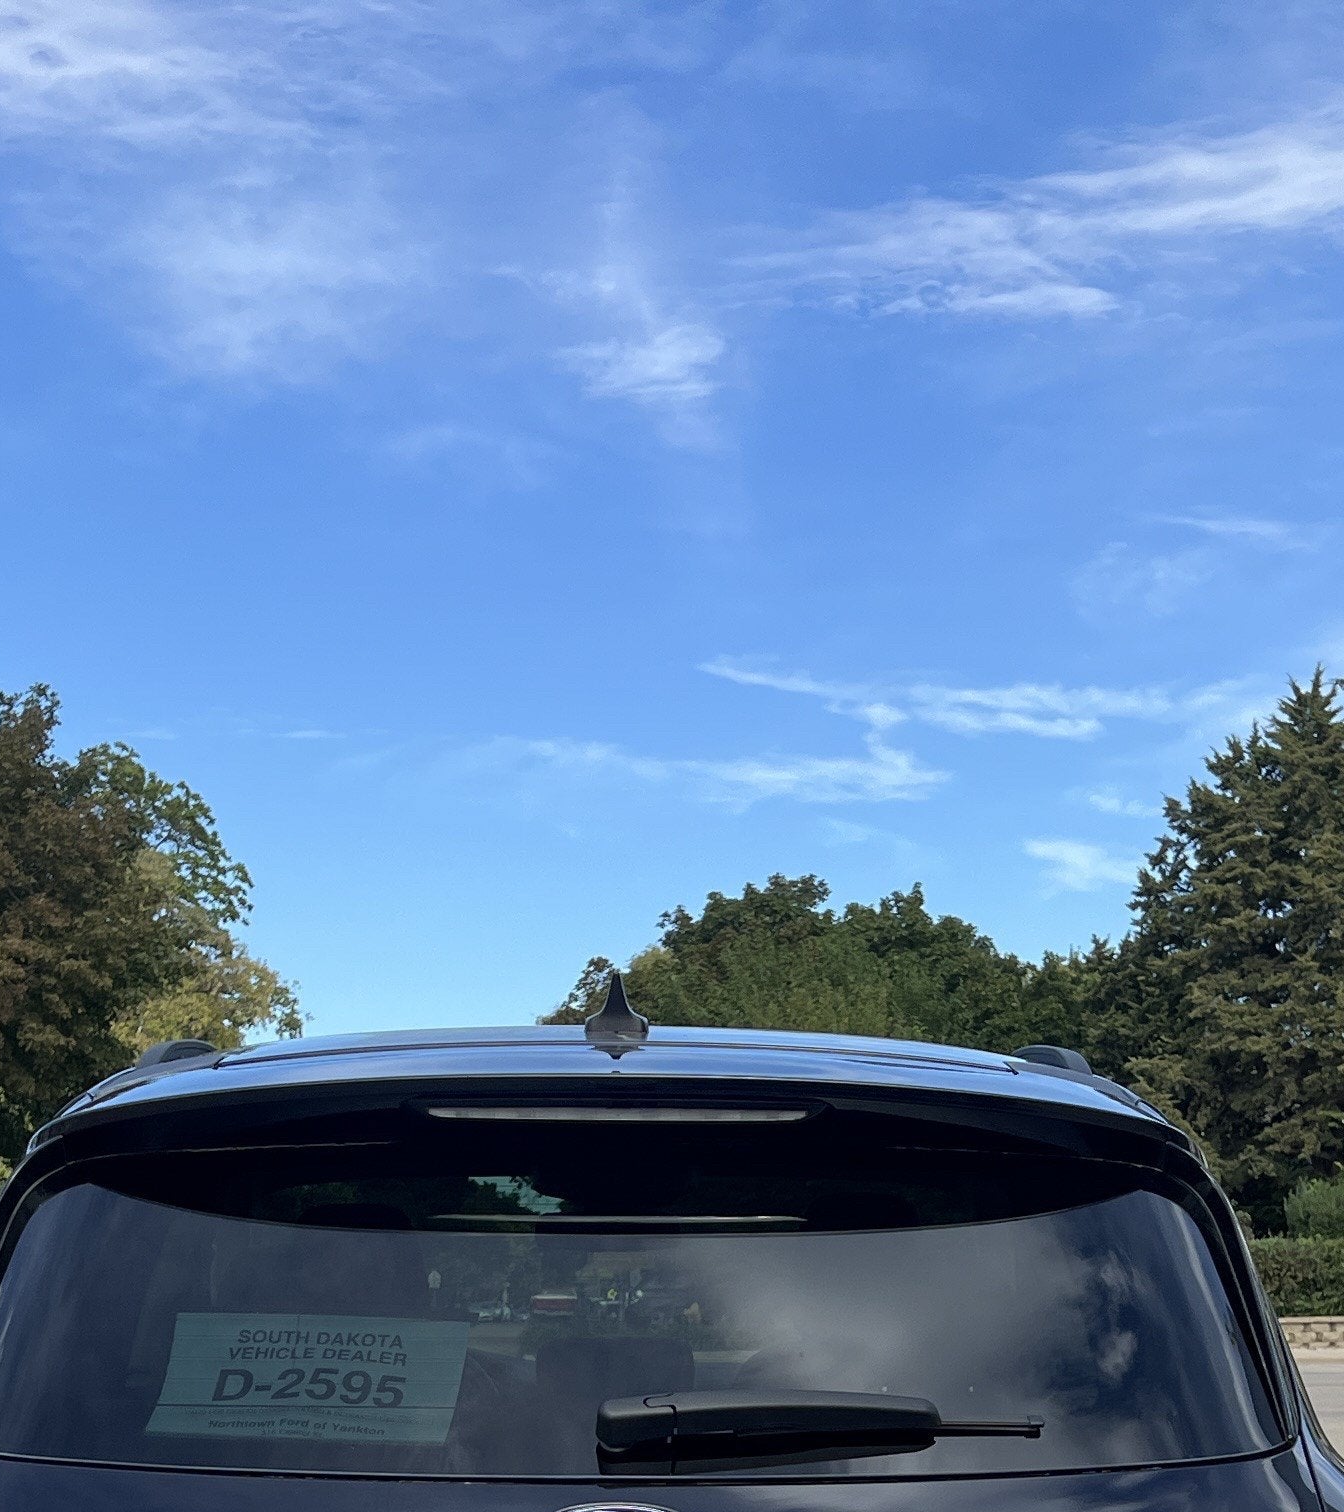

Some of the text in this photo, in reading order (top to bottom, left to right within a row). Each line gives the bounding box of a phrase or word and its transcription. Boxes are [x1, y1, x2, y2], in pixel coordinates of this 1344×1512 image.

[237, 1328, 403, 1349] SOUTH DAKOTA
[228, 1346, 408, 1367] VEHICLE DEALER
[211, 1367, 408, 1408] D-2595
[279, 1418, 310, 1428] Ford
[313, 1421, 328, 1430] of
[332, 1423, 386, 1436] Yankton
